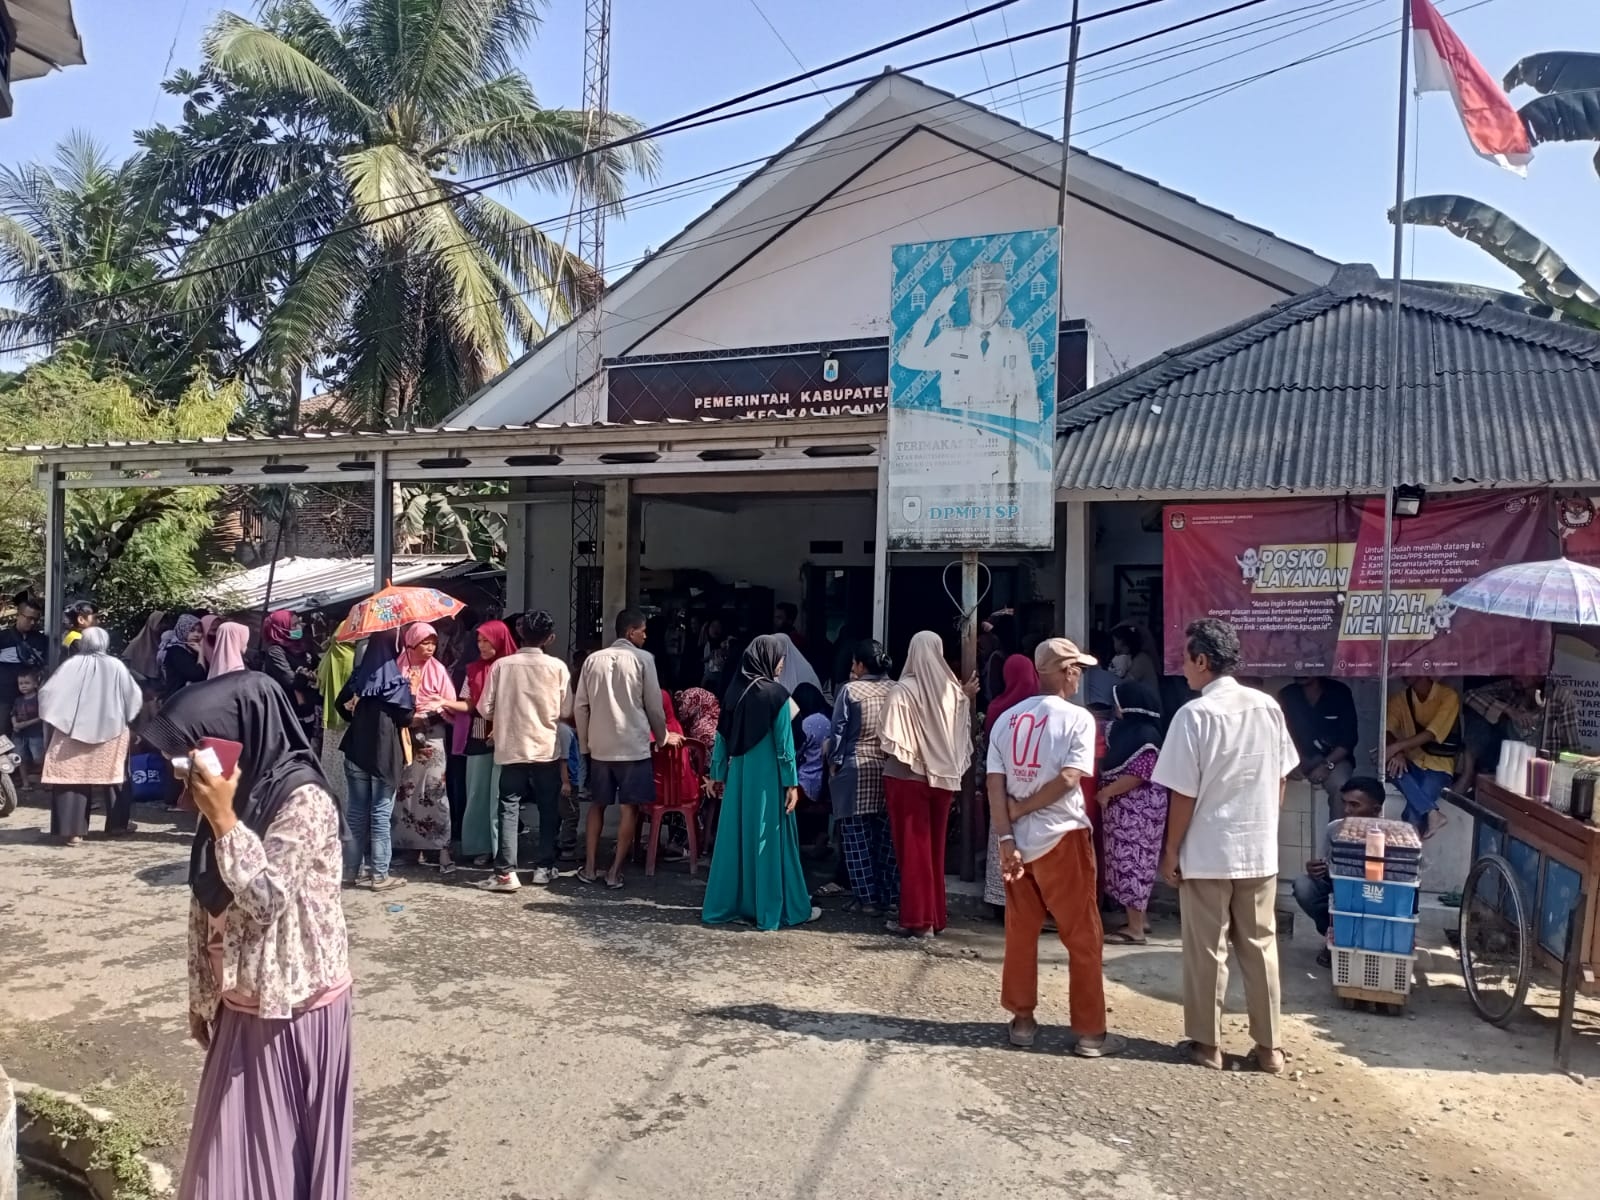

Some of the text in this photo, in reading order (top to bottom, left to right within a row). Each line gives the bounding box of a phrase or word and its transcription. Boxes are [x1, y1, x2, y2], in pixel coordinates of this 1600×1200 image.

[694, 392, 790, 408] PEMERINTAH
[929, 505, 1019, 520] DPMPTSP
[1391, 545, 1412, 553] indah
[1412, 543, 1442, 552] memilih
[1444, 542, 1470, 552] datang
[1261, 549, 1328, 569] POSKO
[1368, 554, 1384, 562] Kant
[1256, 567, 1349, 588] LAYANAN
[1367, 570, 1384, 578] Kant
[1404, 567, 1441, 576] Kabupaten
[1348, 593, 1426, 614] PINDAH
[1343, 614, 1431, 635] MEMILIH
[1553, 679, 1599, 688] ASTIKAN
[1009, 713, 1049, 768] #01
[1578, 730, 1598, 738] 024
